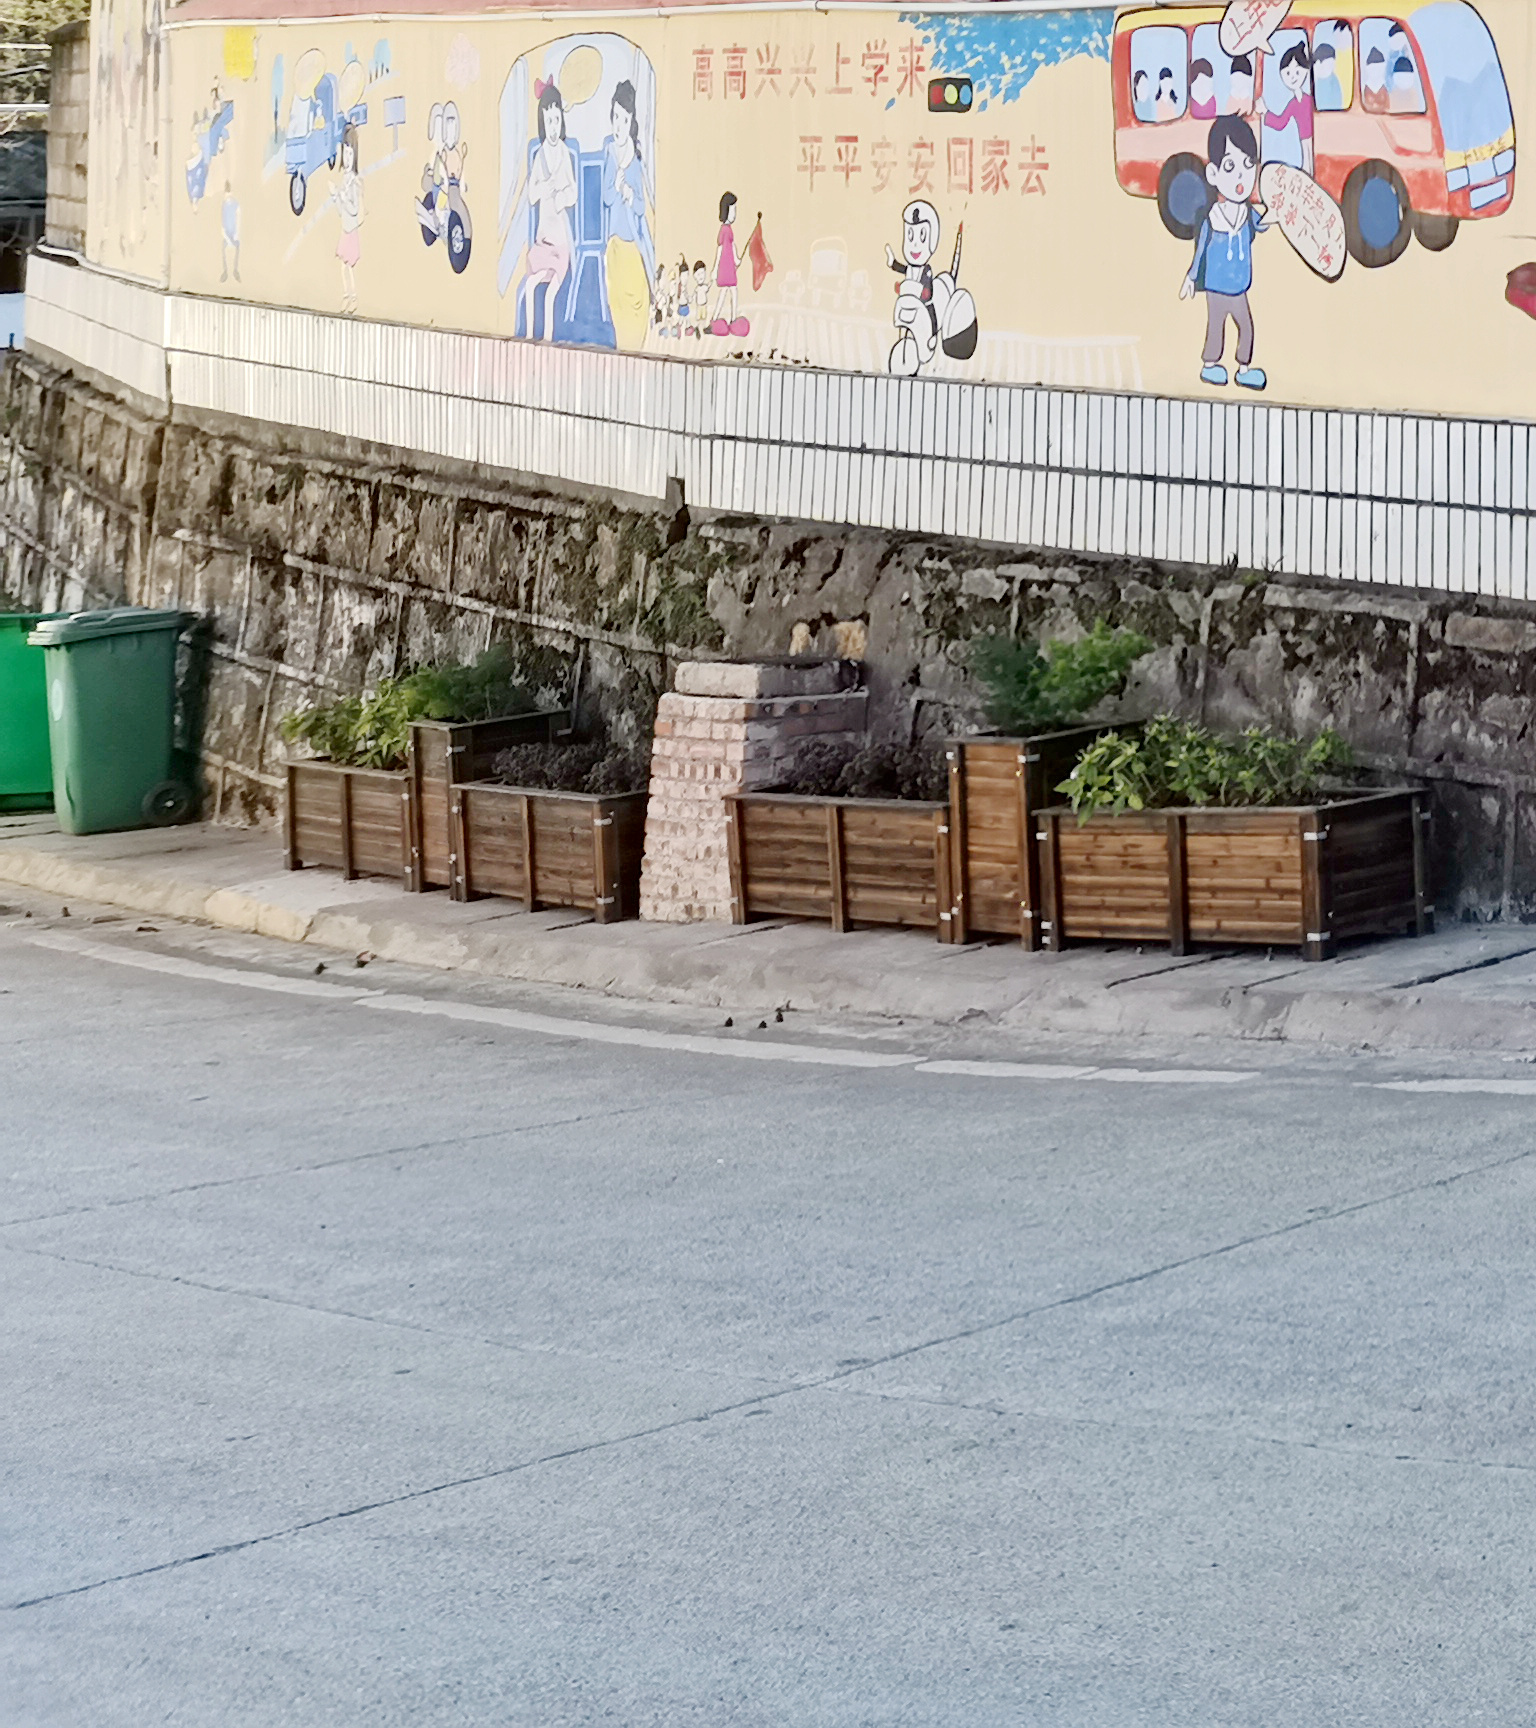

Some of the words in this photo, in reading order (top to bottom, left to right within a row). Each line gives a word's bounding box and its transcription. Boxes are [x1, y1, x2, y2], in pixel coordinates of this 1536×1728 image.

[691, 38, 928, 101] 高高兴兴上学来
[796, 133, 1050, 196] 平平安安回家去
